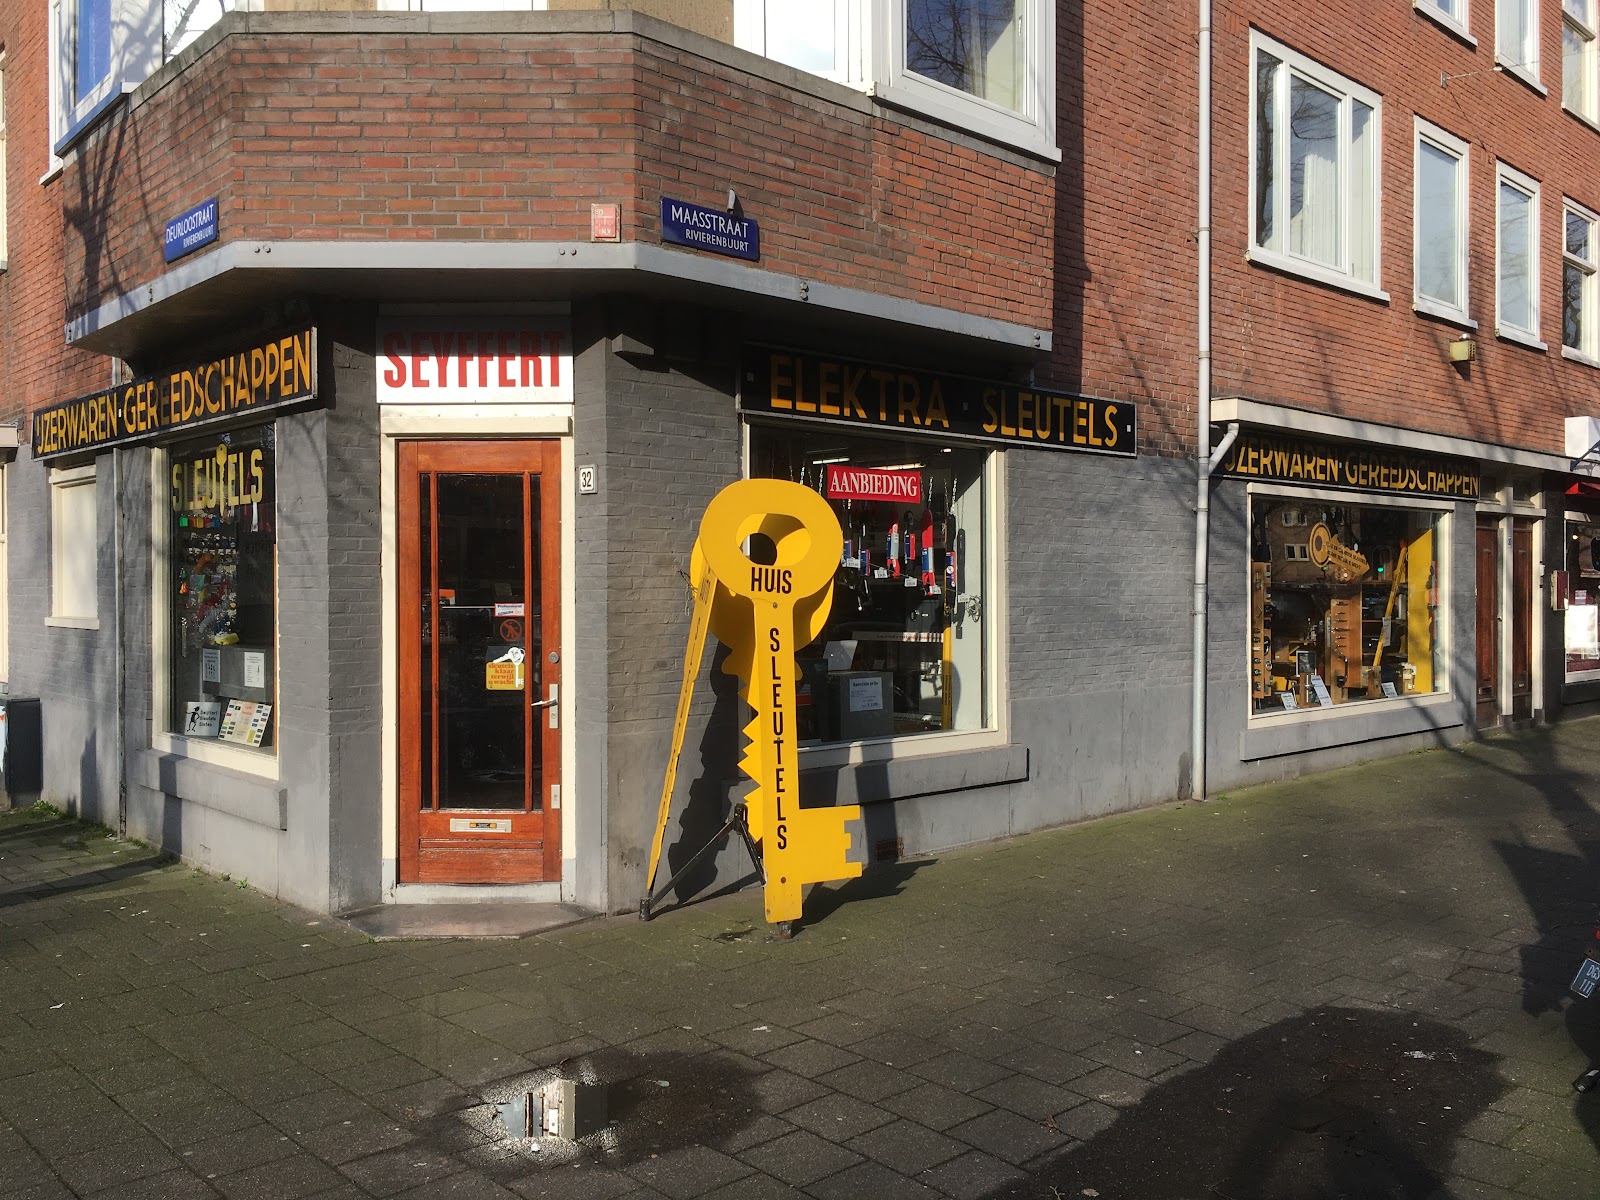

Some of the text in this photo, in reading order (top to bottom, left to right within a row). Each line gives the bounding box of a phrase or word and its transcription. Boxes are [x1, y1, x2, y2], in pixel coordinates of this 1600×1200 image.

[166, 204, 214, 244] DEURLOOSTRAAT
[183, 224, 214, 248] RIVIERENBUURT
[671, 204, 749, 239] MAASSTRAAT
[685, 227, 749, 253] RIVIERENBUURT
[384, 331, 565, 389] SEYFFERT
[123, 331, 311, 434] GEREEDSCHAPPEN
[769, 353, 1119, 448] ELEKTRA SLEUTELS
[172, 446, 263, 515] SLEUTELS
[581, 471, 592, 488] 32
[829, 470, 918, 498] AANBIEDING
[1344, 449, 1480, 496] GEREEDSCHAPPEN
[751, 566, 793, 595] HUIS
[769, 627, 788, 851] SLEUTELS
